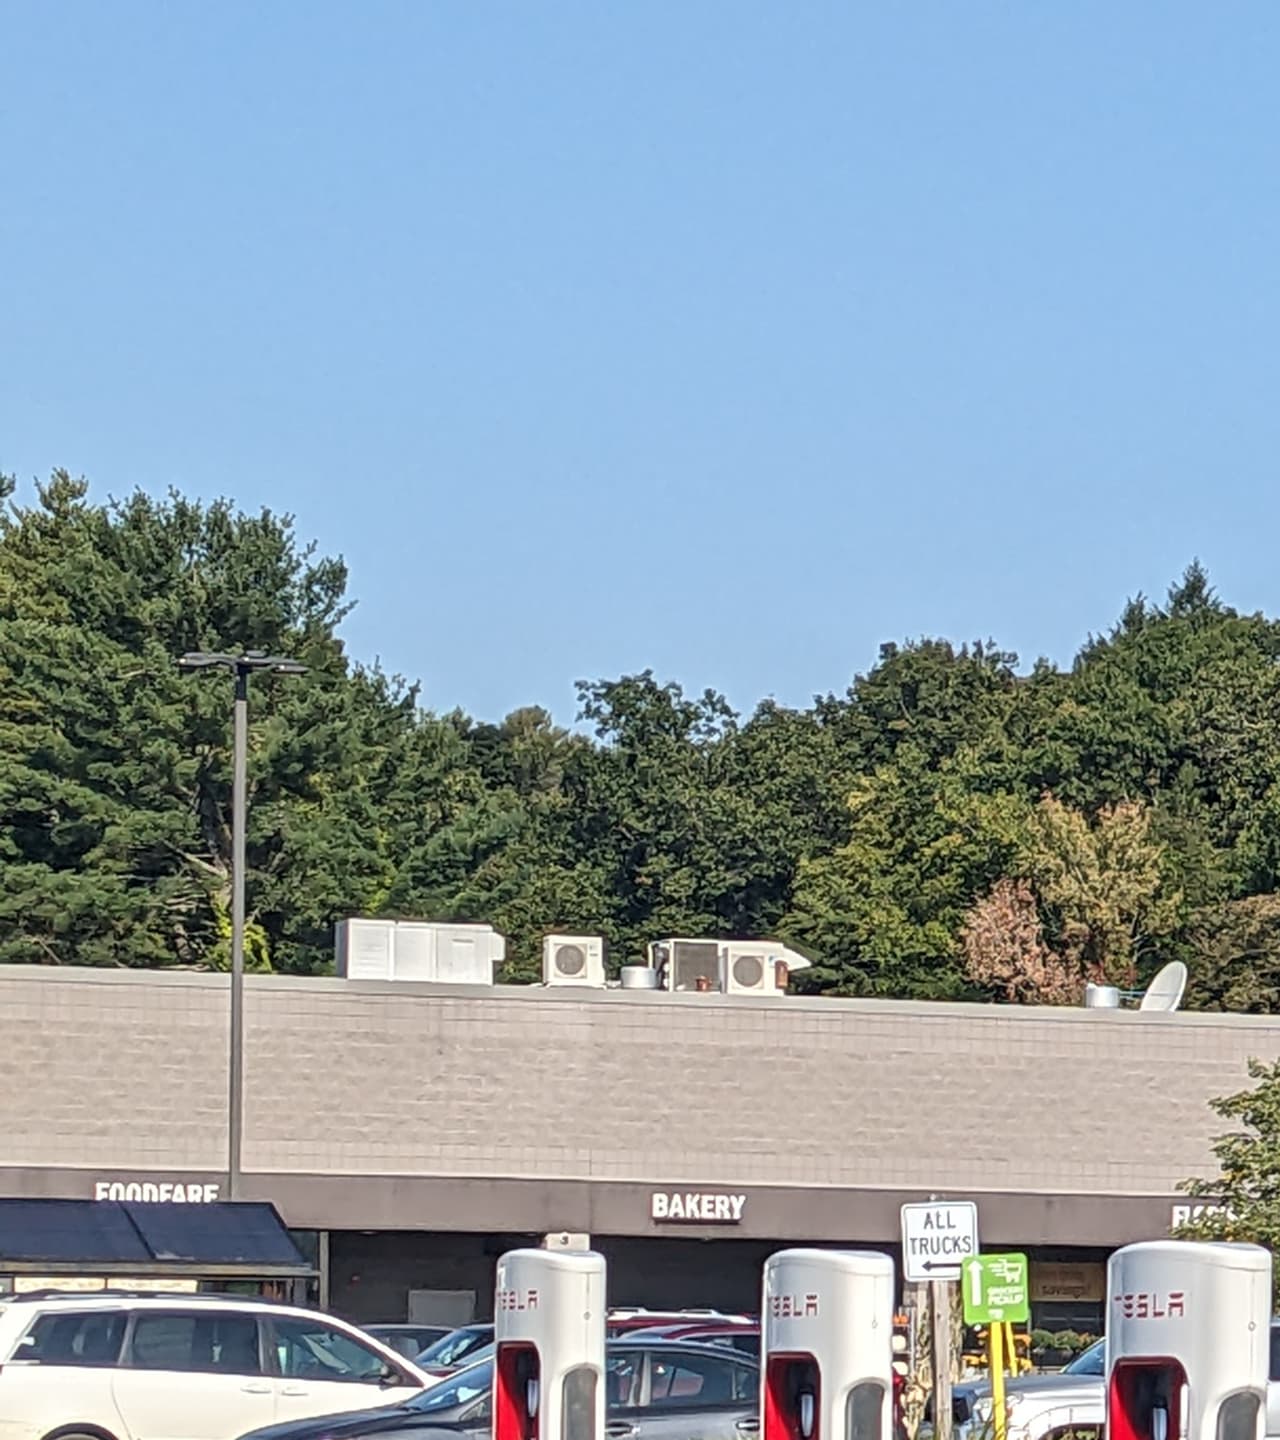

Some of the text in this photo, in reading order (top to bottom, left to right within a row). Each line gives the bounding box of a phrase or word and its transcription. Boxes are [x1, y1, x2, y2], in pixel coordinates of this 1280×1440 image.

[652, 1193, 746, 1220] BAKERY
[923, 1211, 957, 1230] ALL
[909, 1236, 972, 1256] TRUCKS
